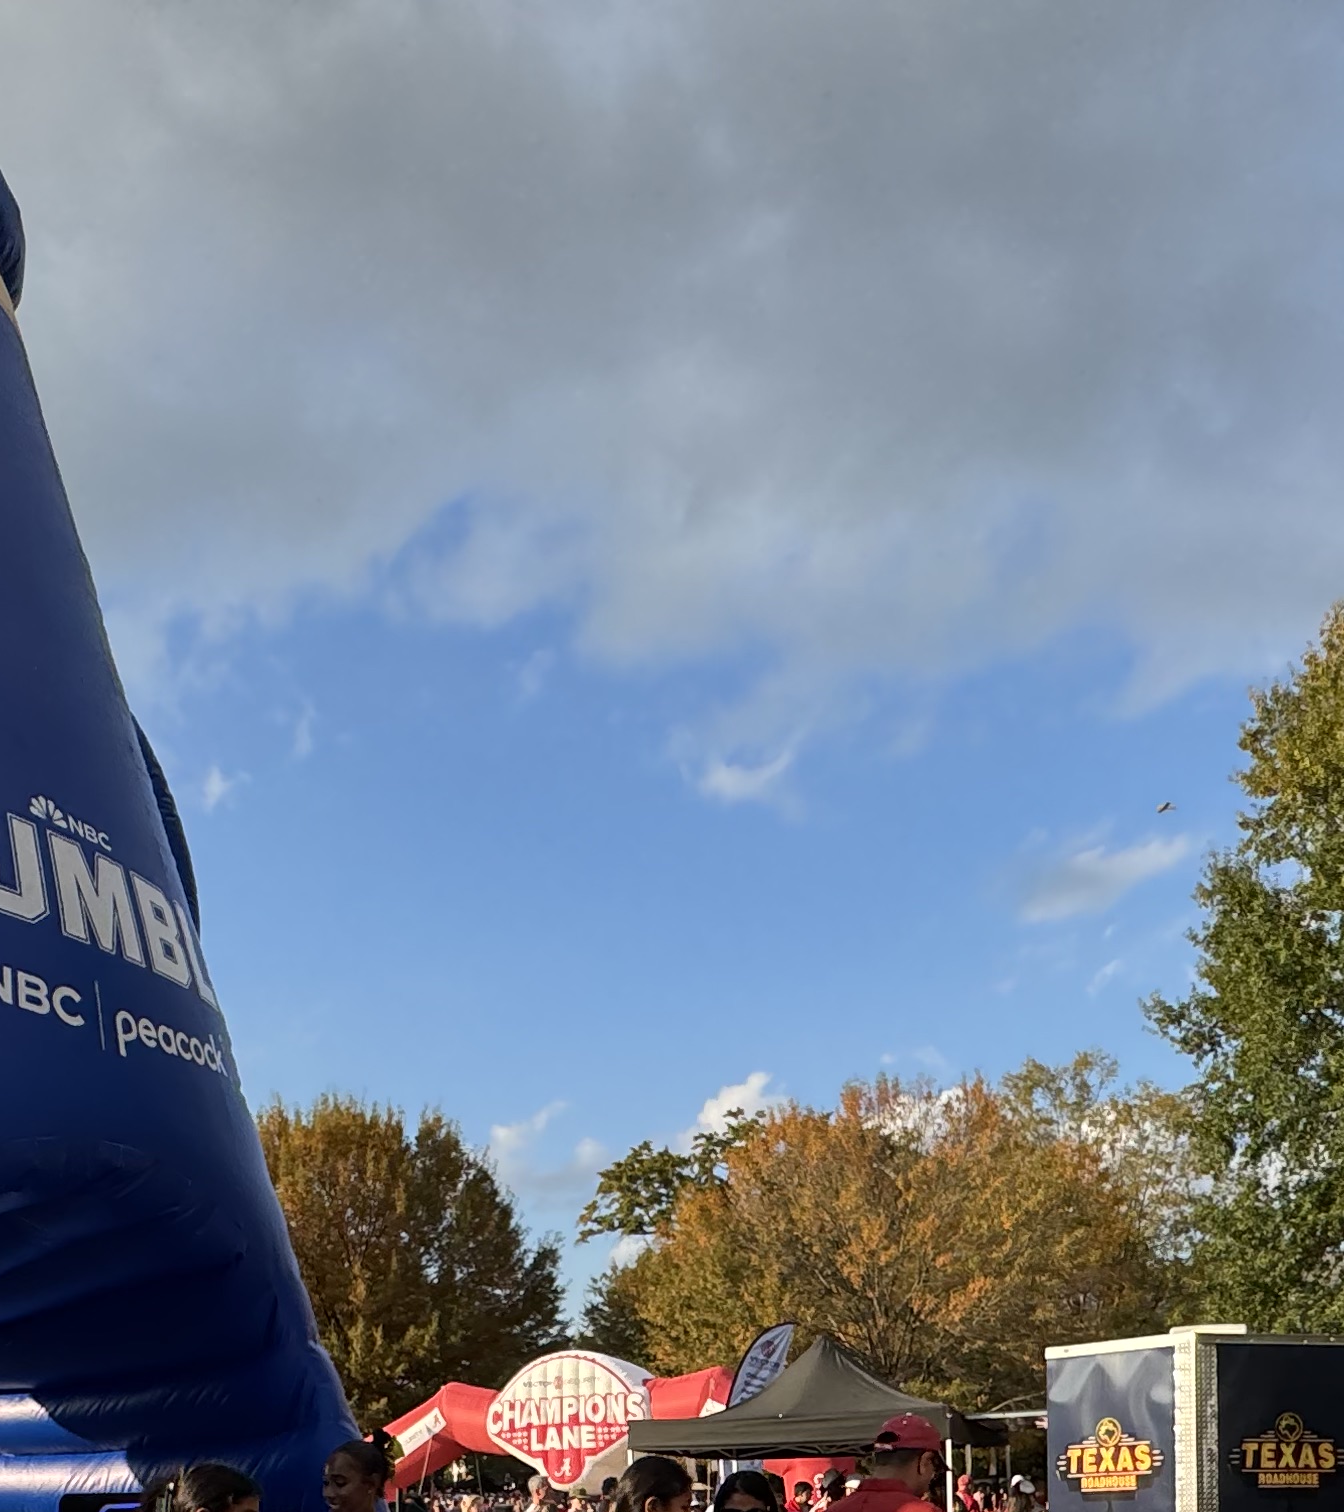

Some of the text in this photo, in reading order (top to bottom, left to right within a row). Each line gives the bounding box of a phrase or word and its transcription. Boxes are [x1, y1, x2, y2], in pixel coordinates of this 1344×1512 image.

[66, 815, 112, 851] NBC
[115, 1009, 228, 1077] peacock
[487, 1393, 644, 1435] CHAMPIONS
[530, 1424, 597, 1451] LANE
[1067, 1444, 1152, 1474] TEXAS
[1241, 1442, 1336, 1469] TEXAS
[1081, 1475, 1137, 1489] ROADHOUSE
[1257, 1473, 1320, 1485] ROADHOUSE
